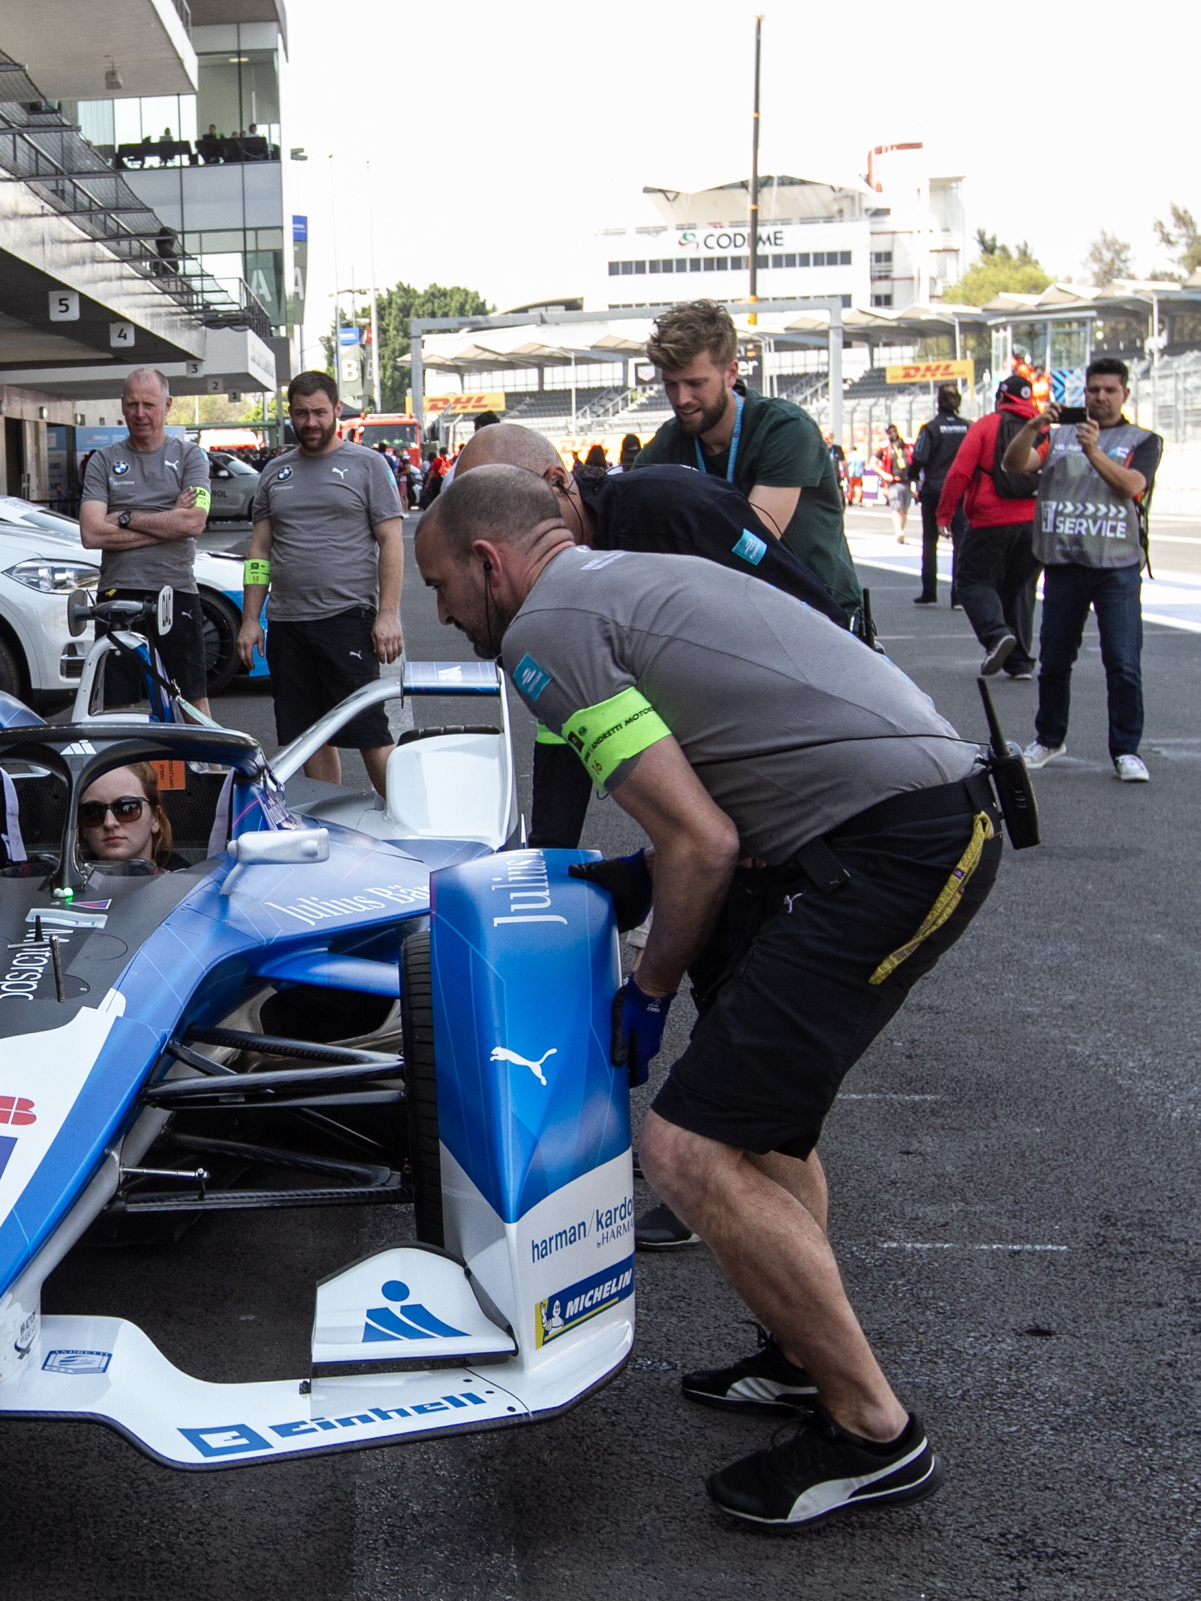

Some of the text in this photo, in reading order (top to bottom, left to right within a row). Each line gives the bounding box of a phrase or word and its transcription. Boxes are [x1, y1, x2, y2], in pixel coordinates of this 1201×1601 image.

[58, 298, 70, 314] 5
[116, 328, 127, 341] 4
[191, 363, 198, 374] 3
[341, 359, 359, 382] B
[901, 364, 955, 379] DHL
[212, 381, 219, 390] 2
[428, 396, 489, 411] DHL
[1056, 516, 1127, 539] SERVICE
[590, 723, 623, 752] ANDRETTI
[492, 859, 568, 927] Julius
[266, 895, 386, 927] Julius
[565, 1268, 633, 1319] MICHELIN
